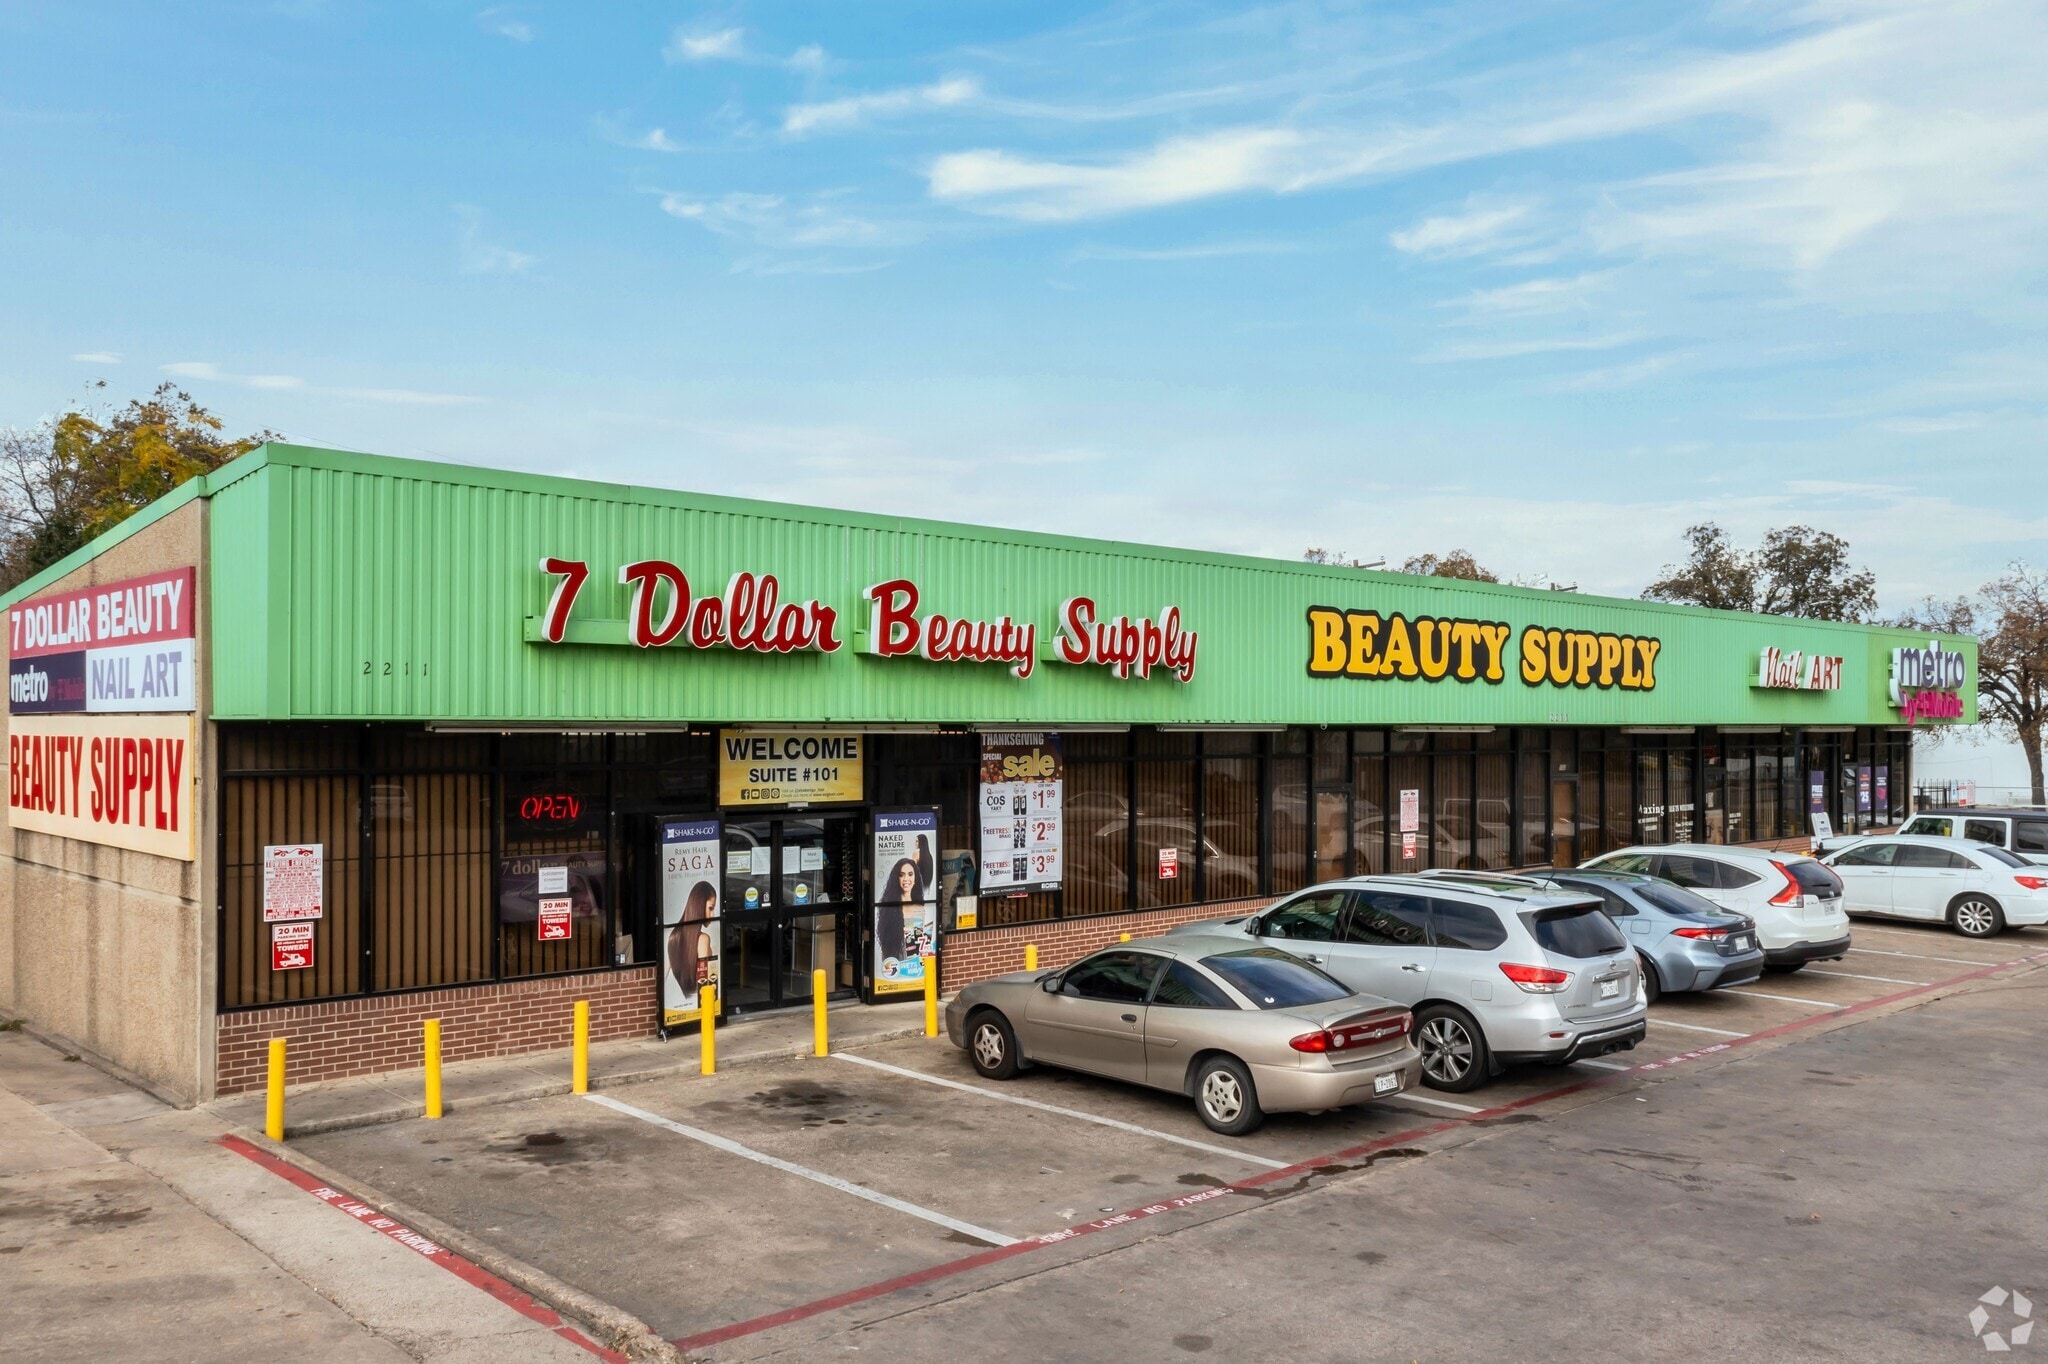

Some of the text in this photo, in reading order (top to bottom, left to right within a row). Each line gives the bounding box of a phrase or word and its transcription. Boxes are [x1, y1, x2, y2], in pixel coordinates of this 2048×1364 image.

[11, 579, 184, 651] 7 DOLLAR BEAUTY
[539, 557, 1198, 683] 7 Dollar Beauty Supply
[1307, 606, 1660, 690] BEAUTY SUPPLY
[92, 651, 182, 700] NAIL ART
[363, 661, 427, 676] 2211
[1759, 646, 1843, 690] Nail ART
[1893, 640, 1965, 689] metro
[10, 665, 48, 702] metro
[725, 737, 858, 761] WELCOME
[981, 732, 1044, 746] THANKSGIVING
[983, 753, 1002, 761] SPECIAL
[1003, 748, 1055, 777] sale
[10, 735, 184, 832] BEAUTY SUPPLY
[749, 767, 839, 783] SUITE #101
[521, 795, 579, 819] OPEN
[674, 826, 714, 837] SHAKE-N-GO
[888, 818, 930, 827] SHAKE-N-GO
[668, 854, 714, 872] SAGA
[292, 926, 309, 934] MIN
[919, 938, 926, 951] 7
[310, 1187, 440, 1255] FIRE LANE NO PARKING
[1040, 1187, 1234, 1243] FIRE LANE NO PARKING
